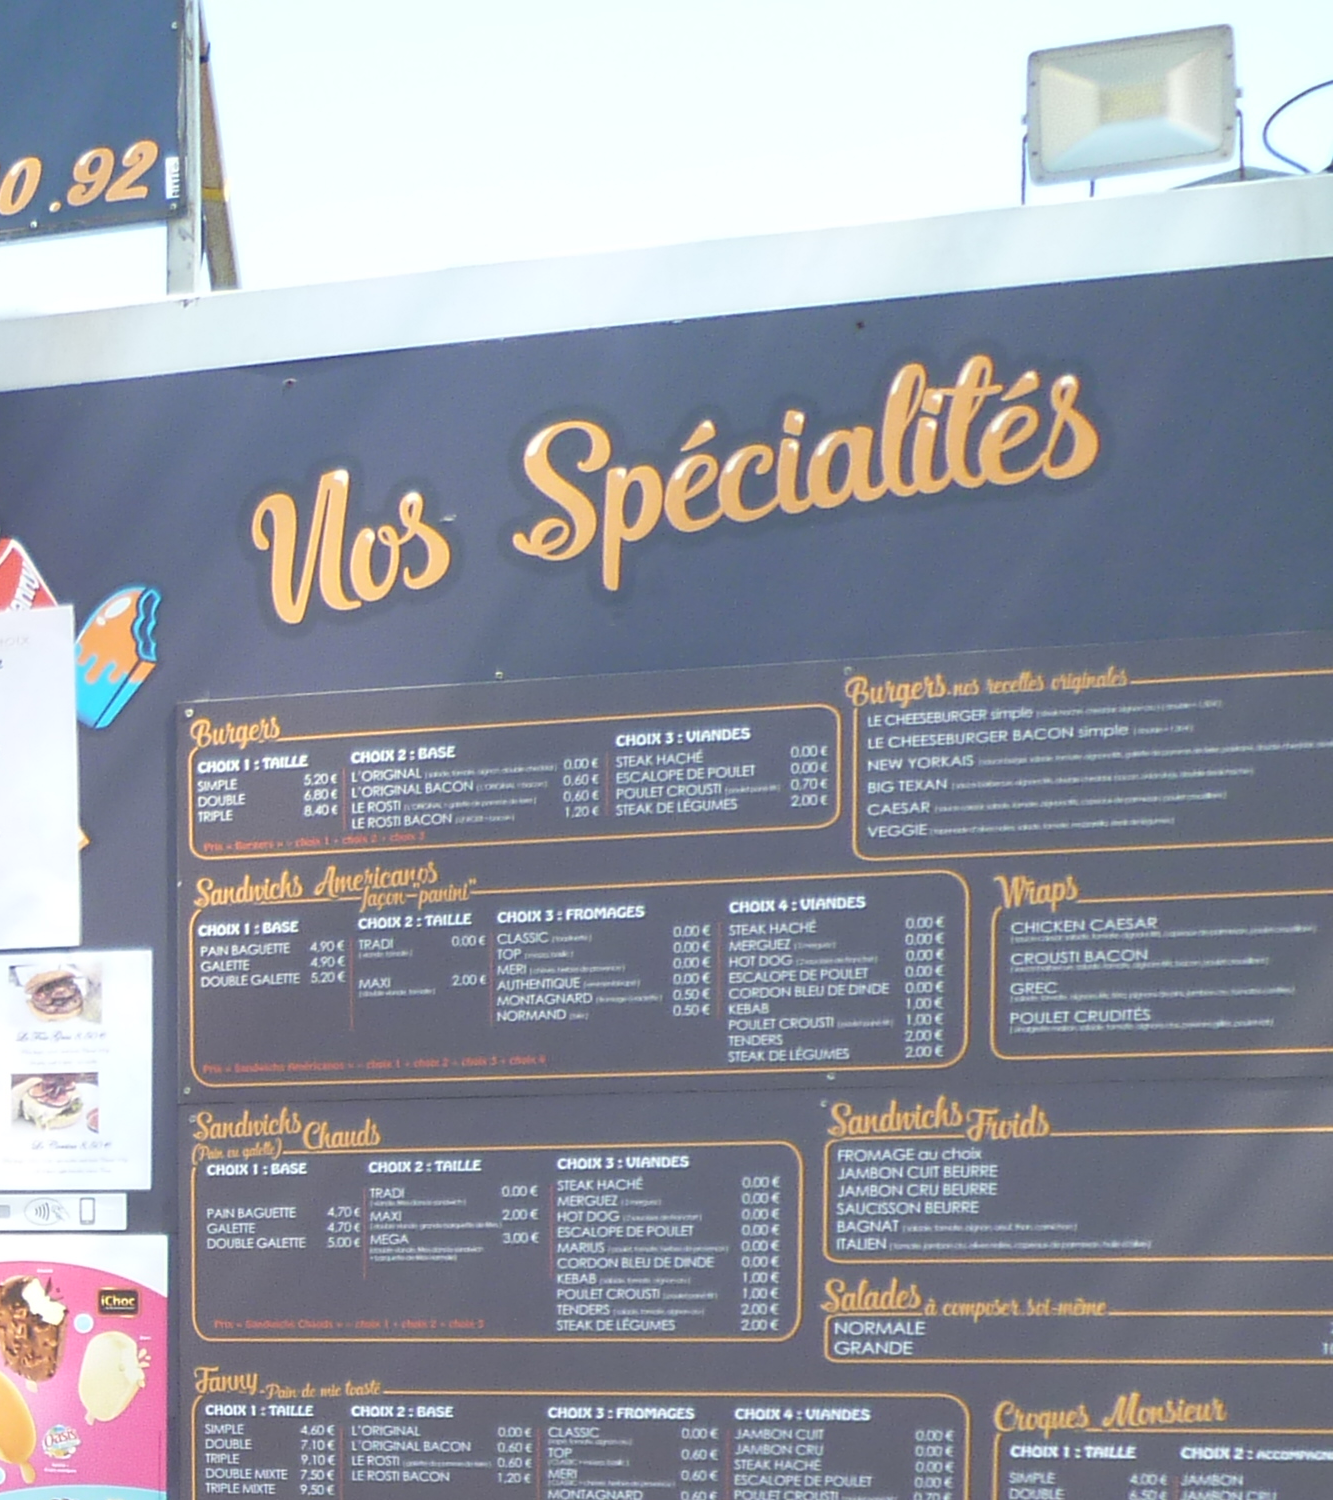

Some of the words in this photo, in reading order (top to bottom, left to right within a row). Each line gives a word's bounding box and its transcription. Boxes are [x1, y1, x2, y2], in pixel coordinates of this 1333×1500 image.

[251, 468, 452, 626] Nos
[511, 353, 1102, 592] Spécialités
[845, 675, 947, 709] Burgers
[868, 714, 882, 728] LE
[884, 709, 988, 729] CHEESEBURGER
[990, 706, 1034, 724] simple
[189, 716, 282, 750] Burgers
[867, 736, 884, 750] LE
[887, 728, 1009, 749] CHEESEBURGER
[1012, 724, 1074, 742] BACON
[1078, 722, 1130, 741] simple
[867, 755, 902, 772] NEW
[905, 752, 975, 770] YORKAIS
[867, 778, 894, 795] BIG
[897, 776, 948, 793] TEXAN
[867, 800, 930, 817] CAESAR
[867, 822, 928, 839] VEGGIE
[193, 876, 304, 908] Sandwichs
[314, 861, 439, 898] Americanos
[993, 874, 1081, 913] Wraps
[1010, 918, 1084, 935] CHICKEN
[1089, 916, 1159, 933] CAESAR
[1010, 949, 1081, 965] CROUSTI
[1084, 947, 1149, 963] BACON
[1009, 1009, 1069, 1026] POULET
[1074, 1006, 1152, 1024] CRUDITÉS
[193, 1107, 303, 1143] Sandwichs
[302, 1116, 381, 1149] Chauds
[828, 1096, 965, 1139] Sandwichs
[964, 1105, 1052, 1143] Froids
[837, 1148, 915, 1162] FROMAGE
[917, 1149, 939, 1162] au
[942, 1147, 983, 1162] choix
[837, 1165, 903, 1180] JAMBON
[906, 1164, 940, 1179] CUIT
[943, 1163, 999, 1179] BEURRE
[836, 1200, 923, 1216] SAUCISSON
[926, 1200, 980, 1216] BEURRE
[100, 1294, 136, 1307] iChoc
[821, 1277, 922, 1316] Salades
[833, 1320, 927, 1337] NORMALE
[833, 1339, 914, 1356] GRANDE
[193, 1366, 260, 1398] Fanny
[993, 1399, 1089, 1435] Croques
[1100, 1391, 1228, 1430] Monsieur
